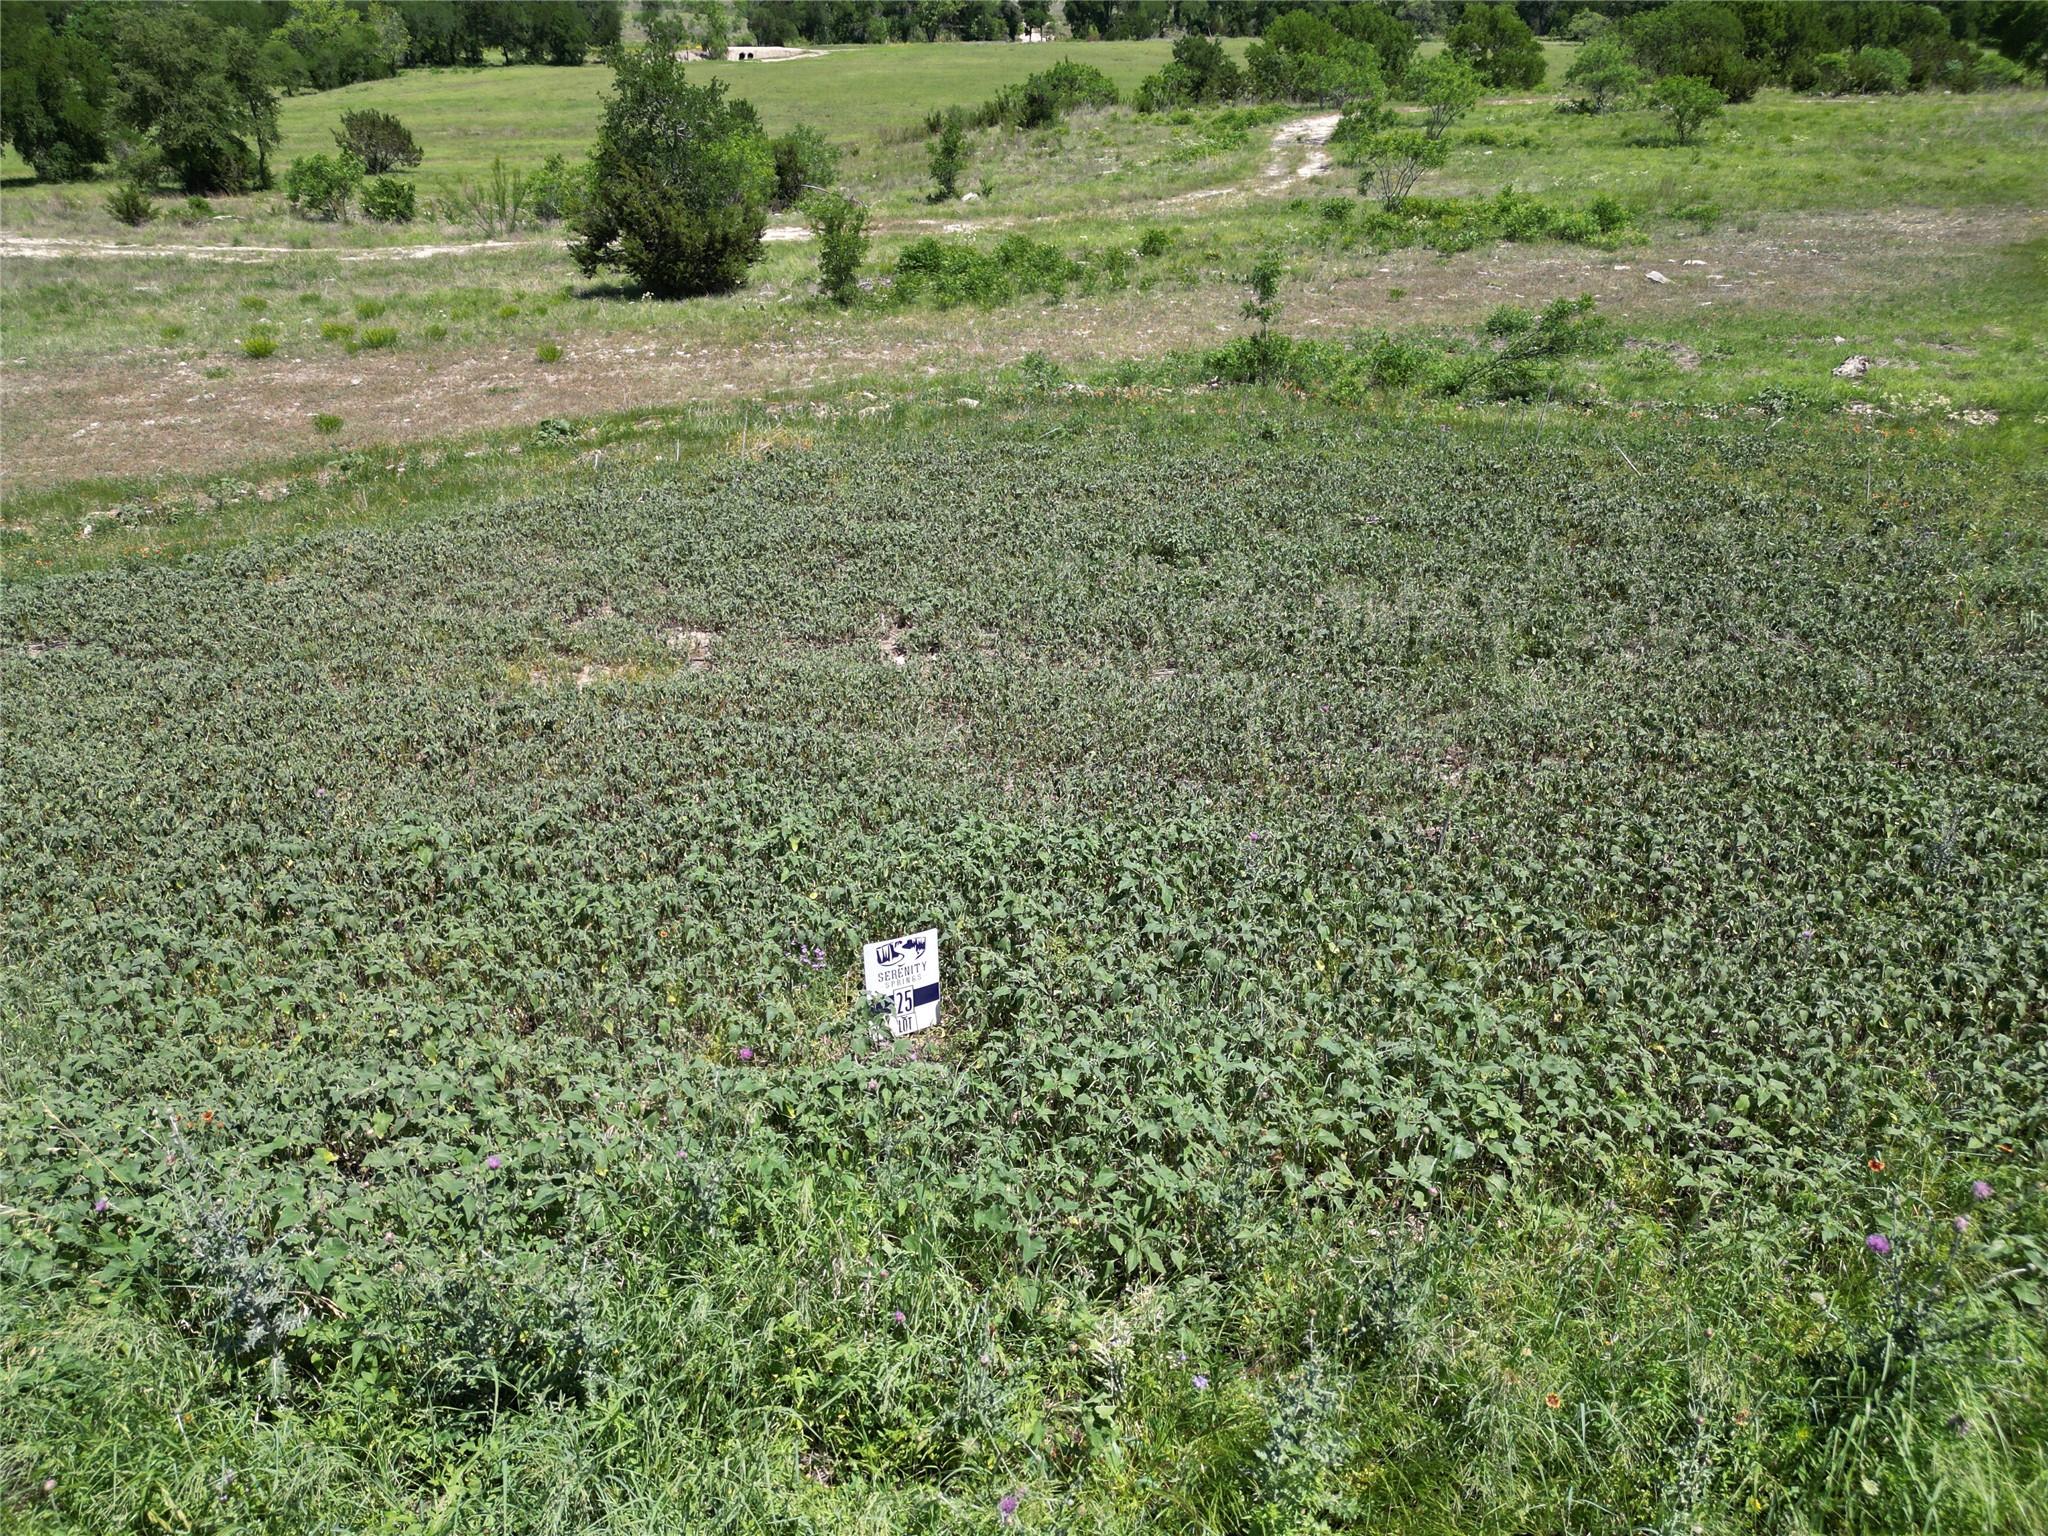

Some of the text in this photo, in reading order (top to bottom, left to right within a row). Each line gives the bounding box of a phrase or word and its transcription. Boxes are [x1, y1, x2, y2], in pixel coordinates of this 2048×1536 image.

[877, 961, 927, 983] SERENITY
[885, 975, 922, 989] SPRINGS
[896, 990, 912, 1014] 25
[898, 1016, 912, 1033] LOT
